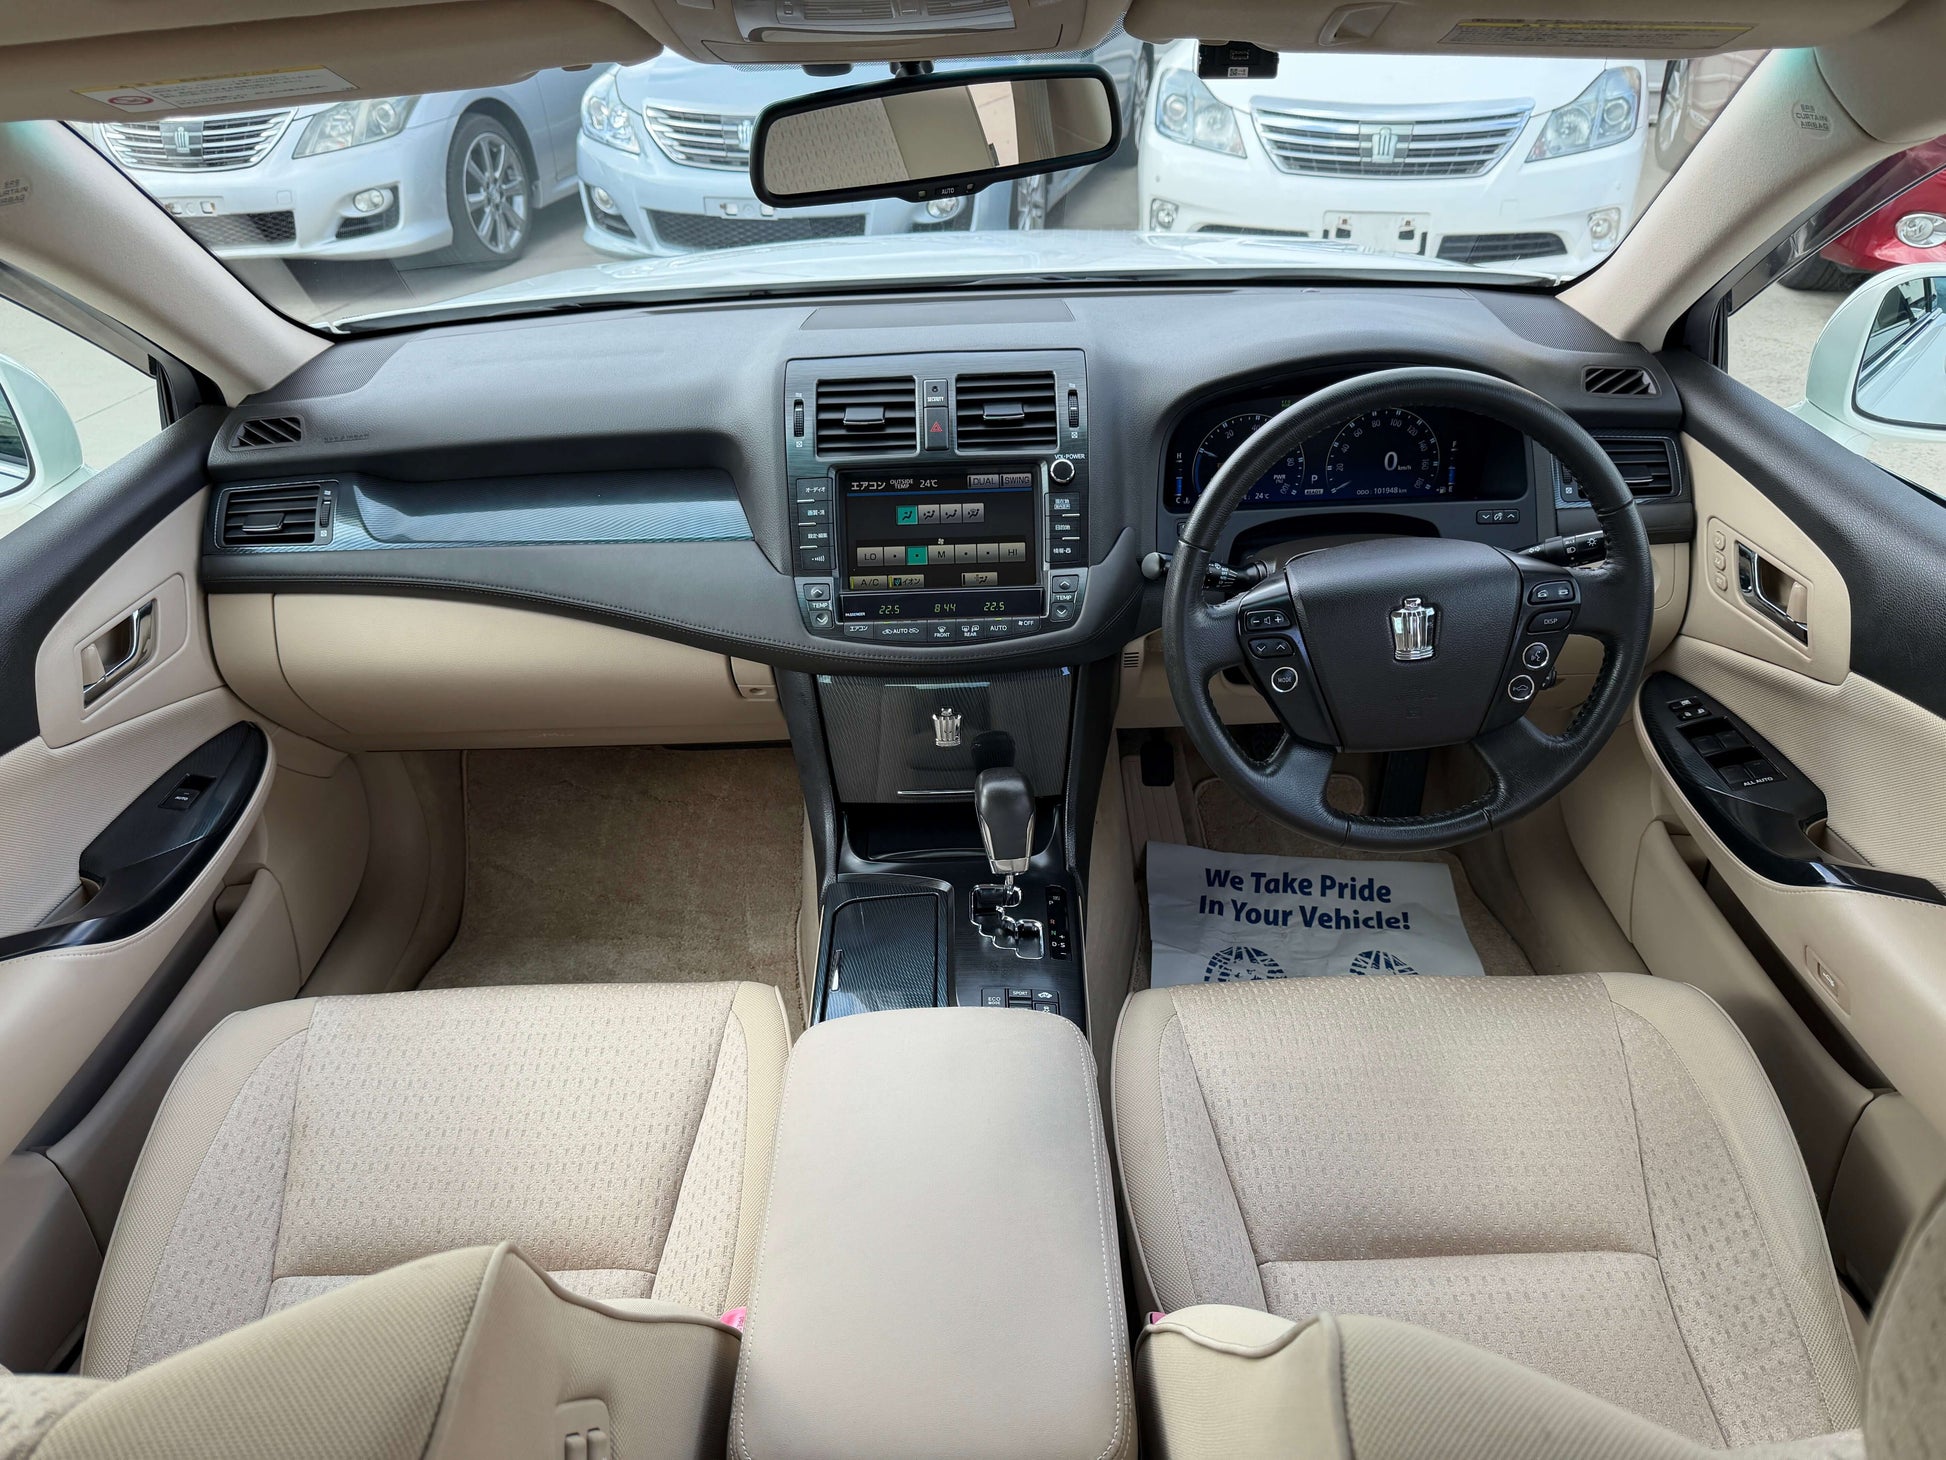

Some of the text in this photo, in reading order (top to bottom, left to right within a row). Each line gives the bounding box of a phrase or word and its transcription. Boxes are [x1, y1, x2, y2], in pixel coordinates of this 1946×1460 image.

[1796, 112, 1828, 122] CURTAIN
[1800, 121, 1829, 130] AIRBAG
[1372, 420, 1380, 428] 80
[1390, 418, 1402, 428] 100
[1224, 430, 1234, 439] 20
[1353, 428, 1363, 438] 60
[1407, 425, 1418, 436] 120
[1341, 444, 1350, 453] 40
[1384, 451, 1398, 471] 0
[1421, 459, 1429, 470] 160
[1336, 463, 1344, 472] 20
[973, 477, 996, 486] DUAL
[1004, 476, 1030, 485] SWING
[1312, 474, 1318, 484] P
[1414, 478, 1424, 488] 180
[851, 482, 886, 490] エアコン
[861, 578, 879, 586] A/C
[902, 578, 920, 586] イオン
[879, 605, 900, 614] 22.5
[984, 602, 1005, 611] 22.5
[1204, 868, 1391, 903] We Take Pride
[1200, 895, 1410, 930] In Your Vehicle!
